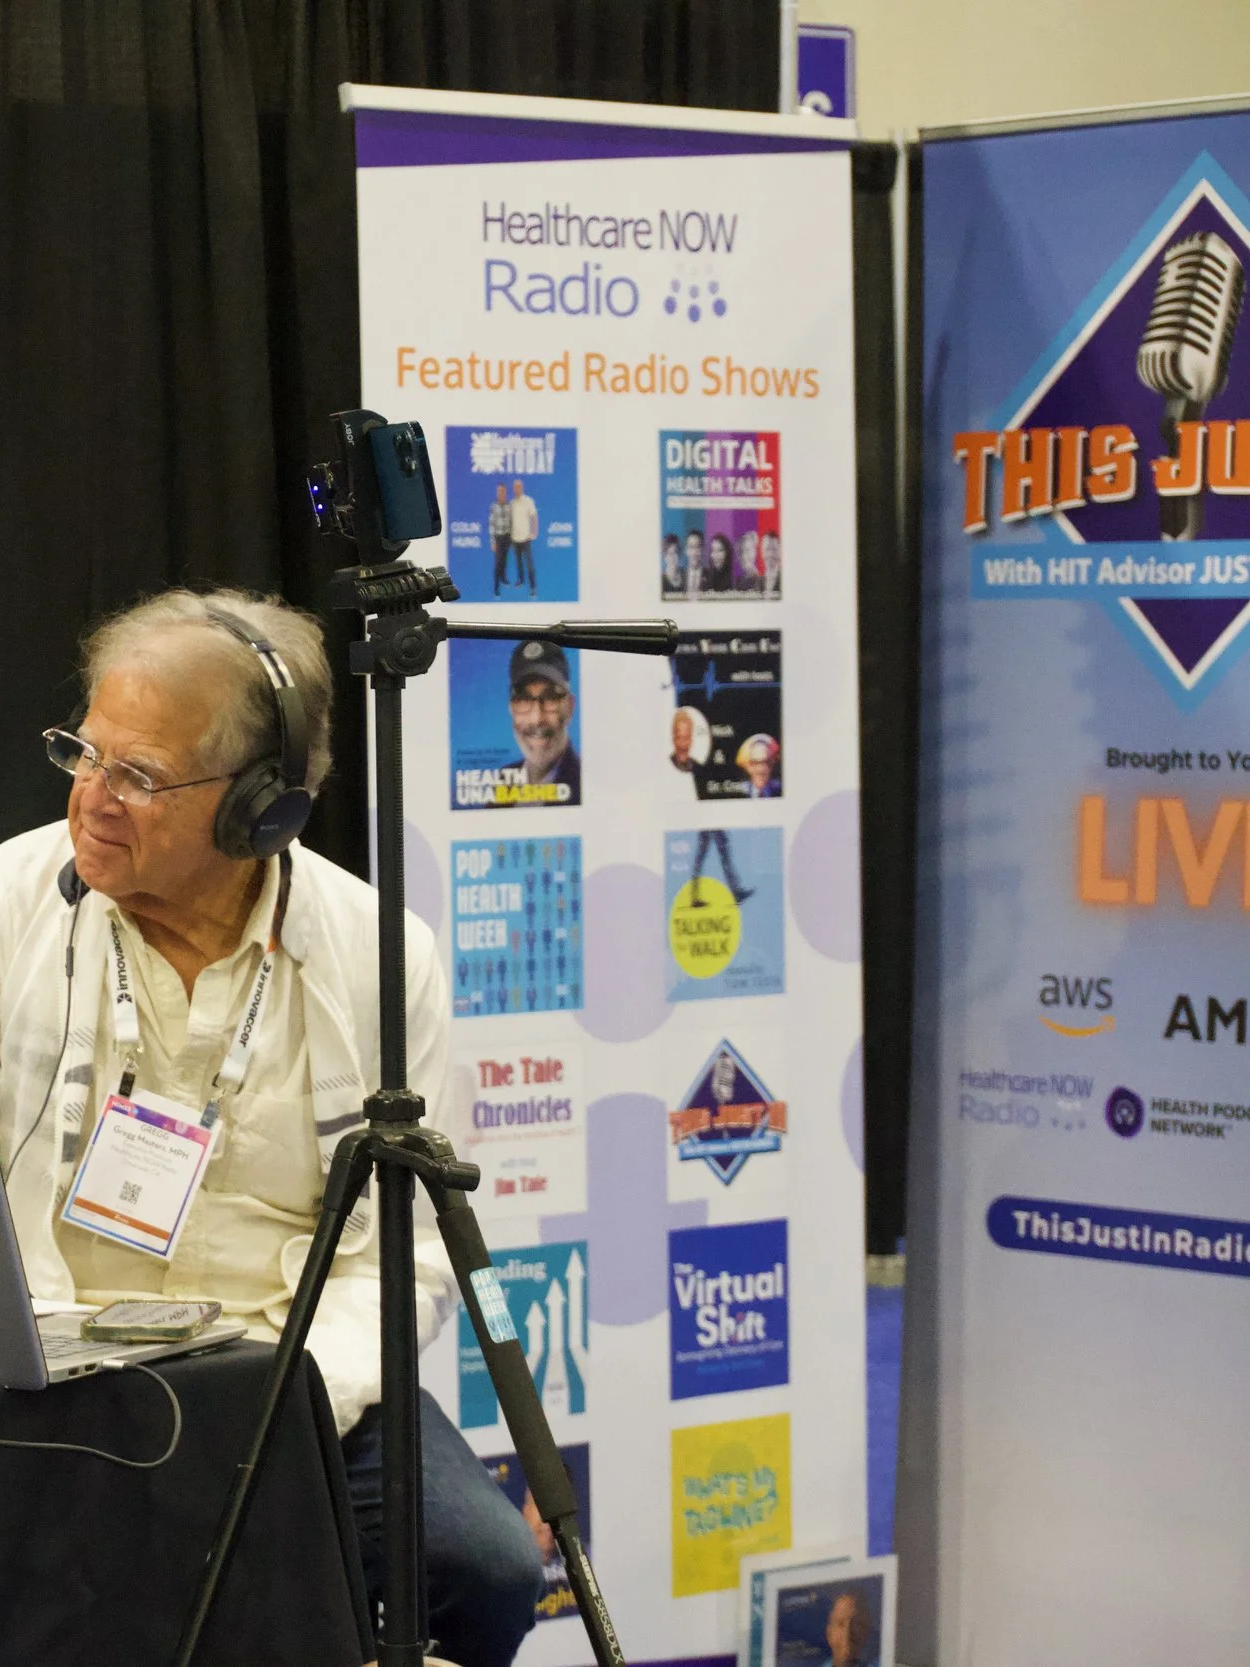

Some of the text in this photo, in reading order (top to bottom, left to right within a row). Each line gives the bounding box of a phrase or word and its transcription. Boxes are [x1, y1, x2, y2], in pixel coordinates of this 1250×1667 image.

[482, 202, 738, 253] Healthcare NOW
[484, 259, 640, 317] Radio
[396, 347, 820, 399] Featured Radio Shows
[666, 439, 774, 471] DIGITAL
[666, 477, 773, 495] HEALTH TALKS
[953, 425, 1139, 535] THIS
[984, 556, 1042, 585] With
[1050, 557, 1092, 585] HIT
[1097, 556, 1195, 585] Advisor
[1106, 747, 1192, 774] Brought
[1199, 751, 1221, 770] to
[456, 767, 528, 787] HEALTH
[456, 782, 570, 805] UNABASHED
[456, 849, 492, 879] POP
[1080, 795, 1250, 910] LIV
[456, 883, 522, 915] HEALTH
[457, 919, 507, 951] WEEK
[674, 916, 731, 935] TALKING
[1039, 973, 1113, 1010] aws
[1163, 993, 1247, 1045] AM
[478, 1058, 514, 1088] The
[960, 1068, 1095, 1099] Healthcare NOW
[472, 1096, 572, 1130] Chronicles
[960, 1093, 1040, 1128] Radio
[1151, 1098, 1250, 1120] HEALTH POD
[1150, 1119, 1226, 1140] NETWORK
[1012, 1209, 1250, 1265] ThisJustInRadi
[674, 1263, 784, 1310] Virtual
[696, 1303, 767, 1347] Shift
[595, 1597, 624, 1665] 5858DLX
